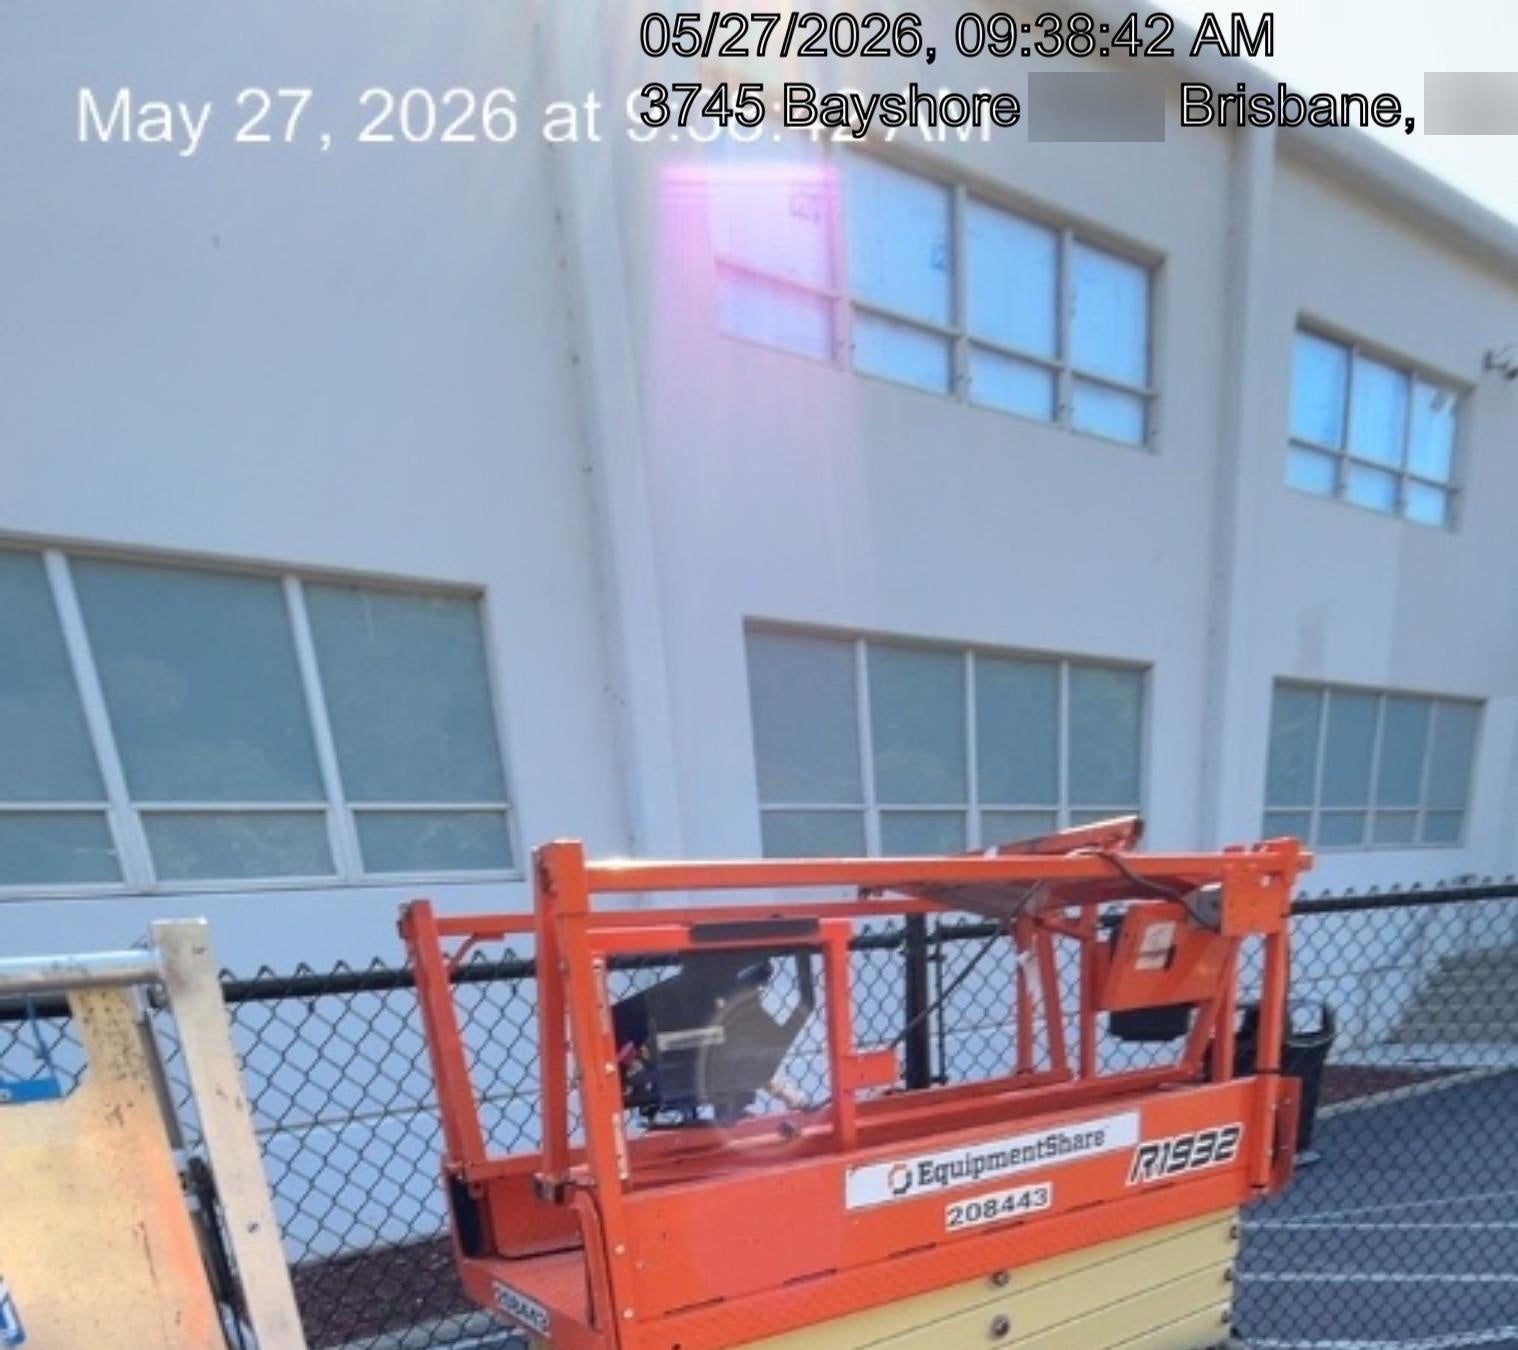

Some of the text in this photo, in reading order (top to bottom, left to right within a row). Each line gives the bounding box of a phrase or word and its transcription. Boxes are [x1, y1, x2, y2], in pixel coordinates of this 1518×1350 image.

[917, 1129, 1105, 1187] EquipmentShare
[1128, 1124, 1242, 1184] R1932
[947, 1187, 1048, 1227] 208443
